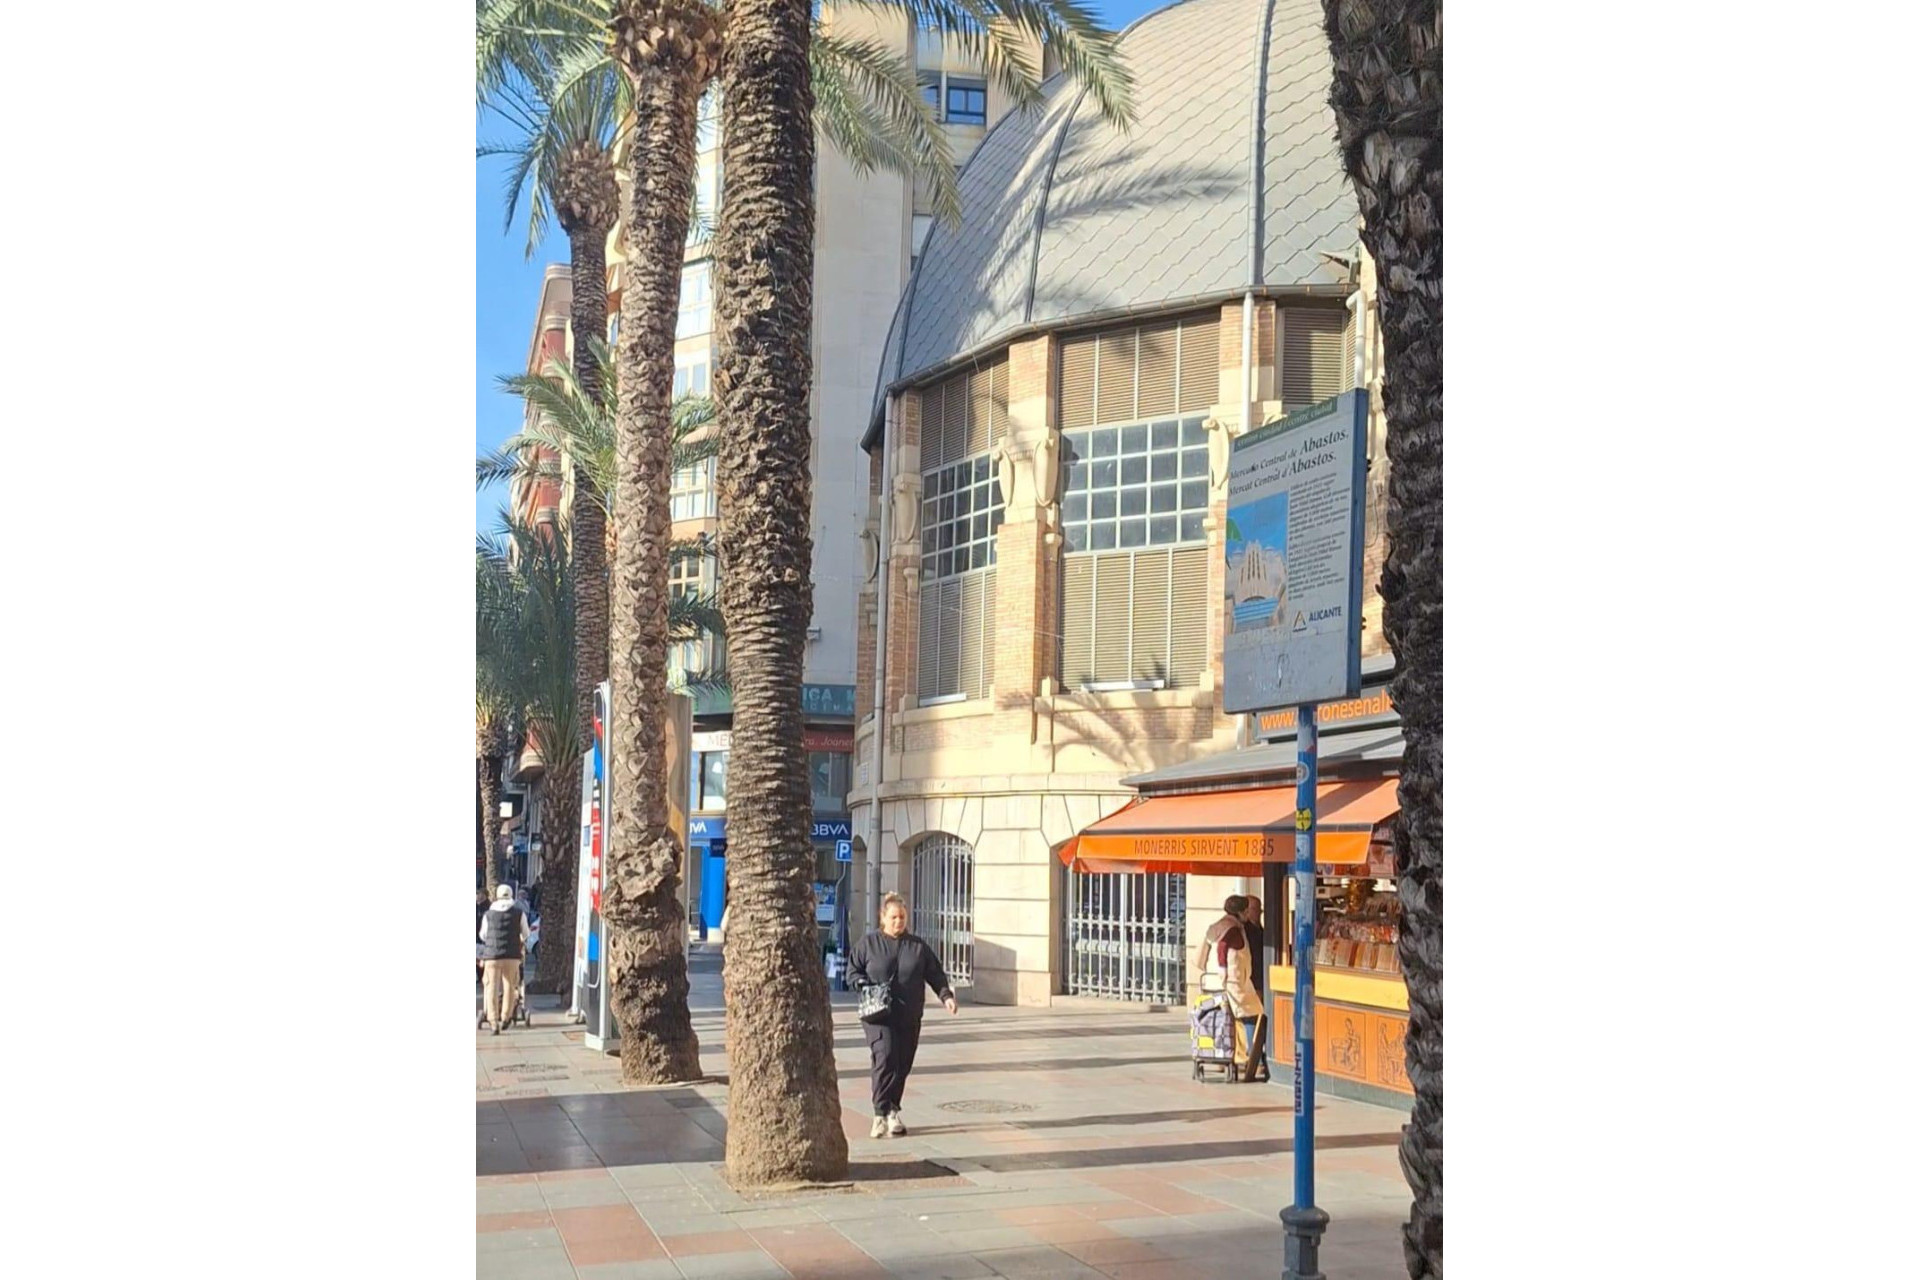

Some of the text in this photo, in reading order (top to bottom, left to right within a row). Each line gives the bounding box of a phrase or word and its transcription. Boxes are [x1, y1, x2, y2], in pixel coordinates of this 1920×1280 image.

[1260, 449, 1287, 469] Central
[1287, 447, 1298, 459] de
[1299, 429, 1349, 455] Abastos.
[1229, 480, 1253, 495] Mercat
[1254, 469, 1280, 488] Central
[1309, 605, 1342, 622] ALICANTE
[839, 842, 850, 858] P
[1134, 838, 1275, 857] MONERRIS SIRVENT 1885
